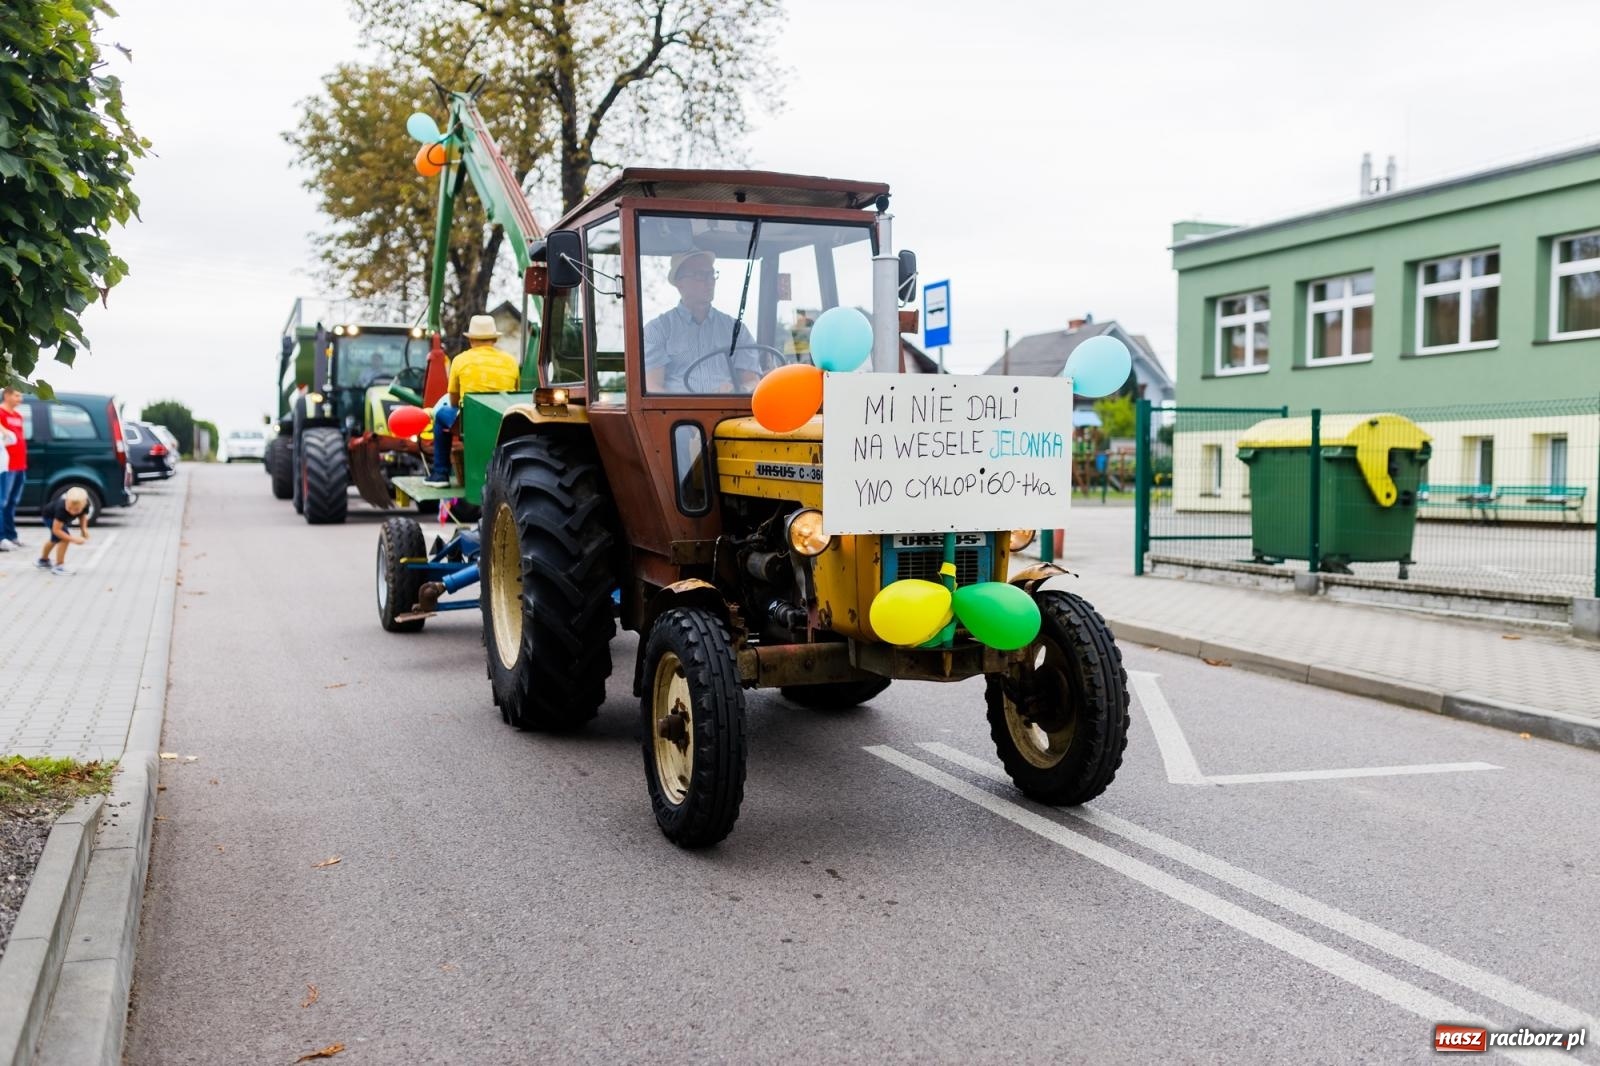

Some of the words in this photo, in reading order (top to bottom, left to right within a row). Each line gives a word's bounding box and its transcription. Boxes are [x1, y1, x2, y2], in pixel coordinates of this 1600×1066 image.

[854, 433, 883, 462] NA
[894, 430, 984, 459] WESELE
[989, 429, 1063, 459] JELONKA
[756, 463, 797, 479] URSUS
[854, 478, 893, 507] YNO
